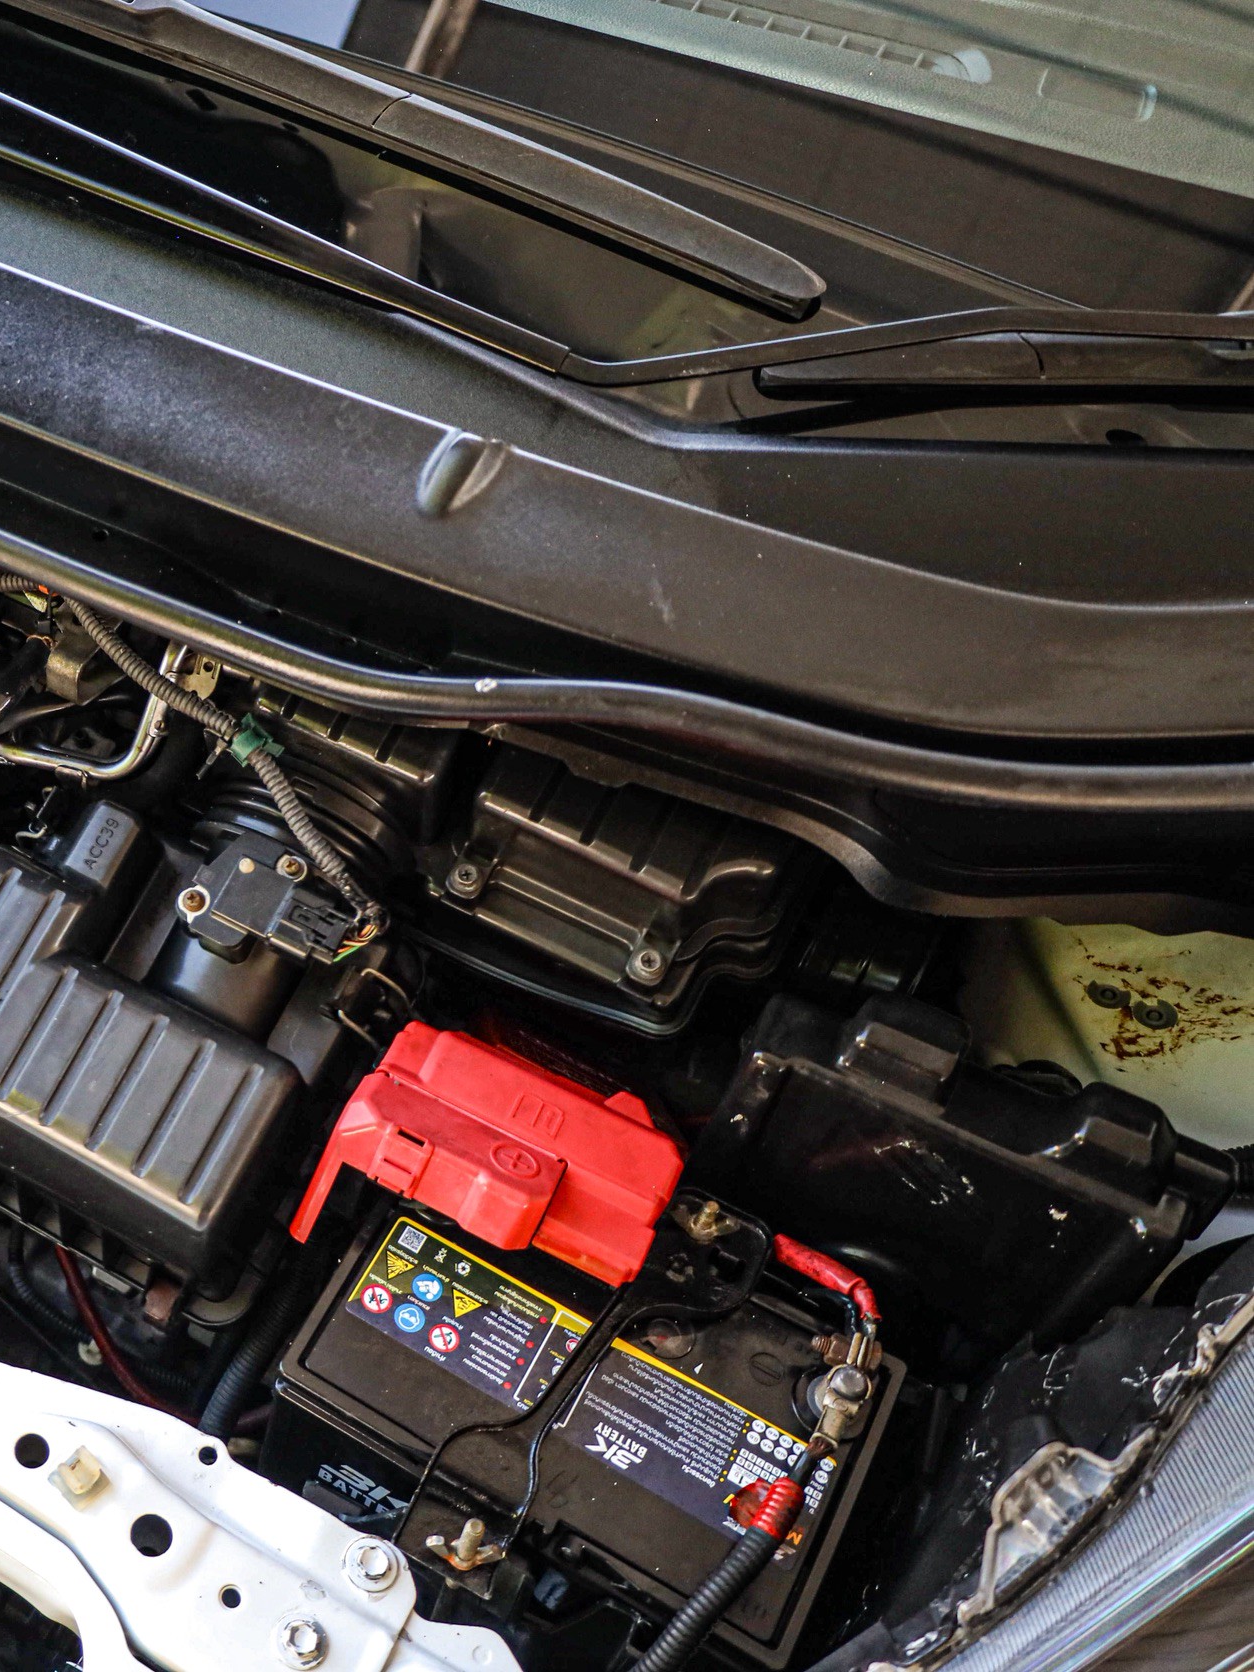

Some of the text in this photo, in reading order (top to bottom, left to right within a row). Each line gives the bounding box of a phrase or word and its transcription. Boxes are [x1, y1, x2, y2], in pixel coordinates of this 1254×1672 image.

[84, 817, 119, 870] ACC39
[585, 1433, 642, 1470] 3K
[593, 1421, 648, 1459] BATTERY
[317, 1467, 390, 1514] BATTE
